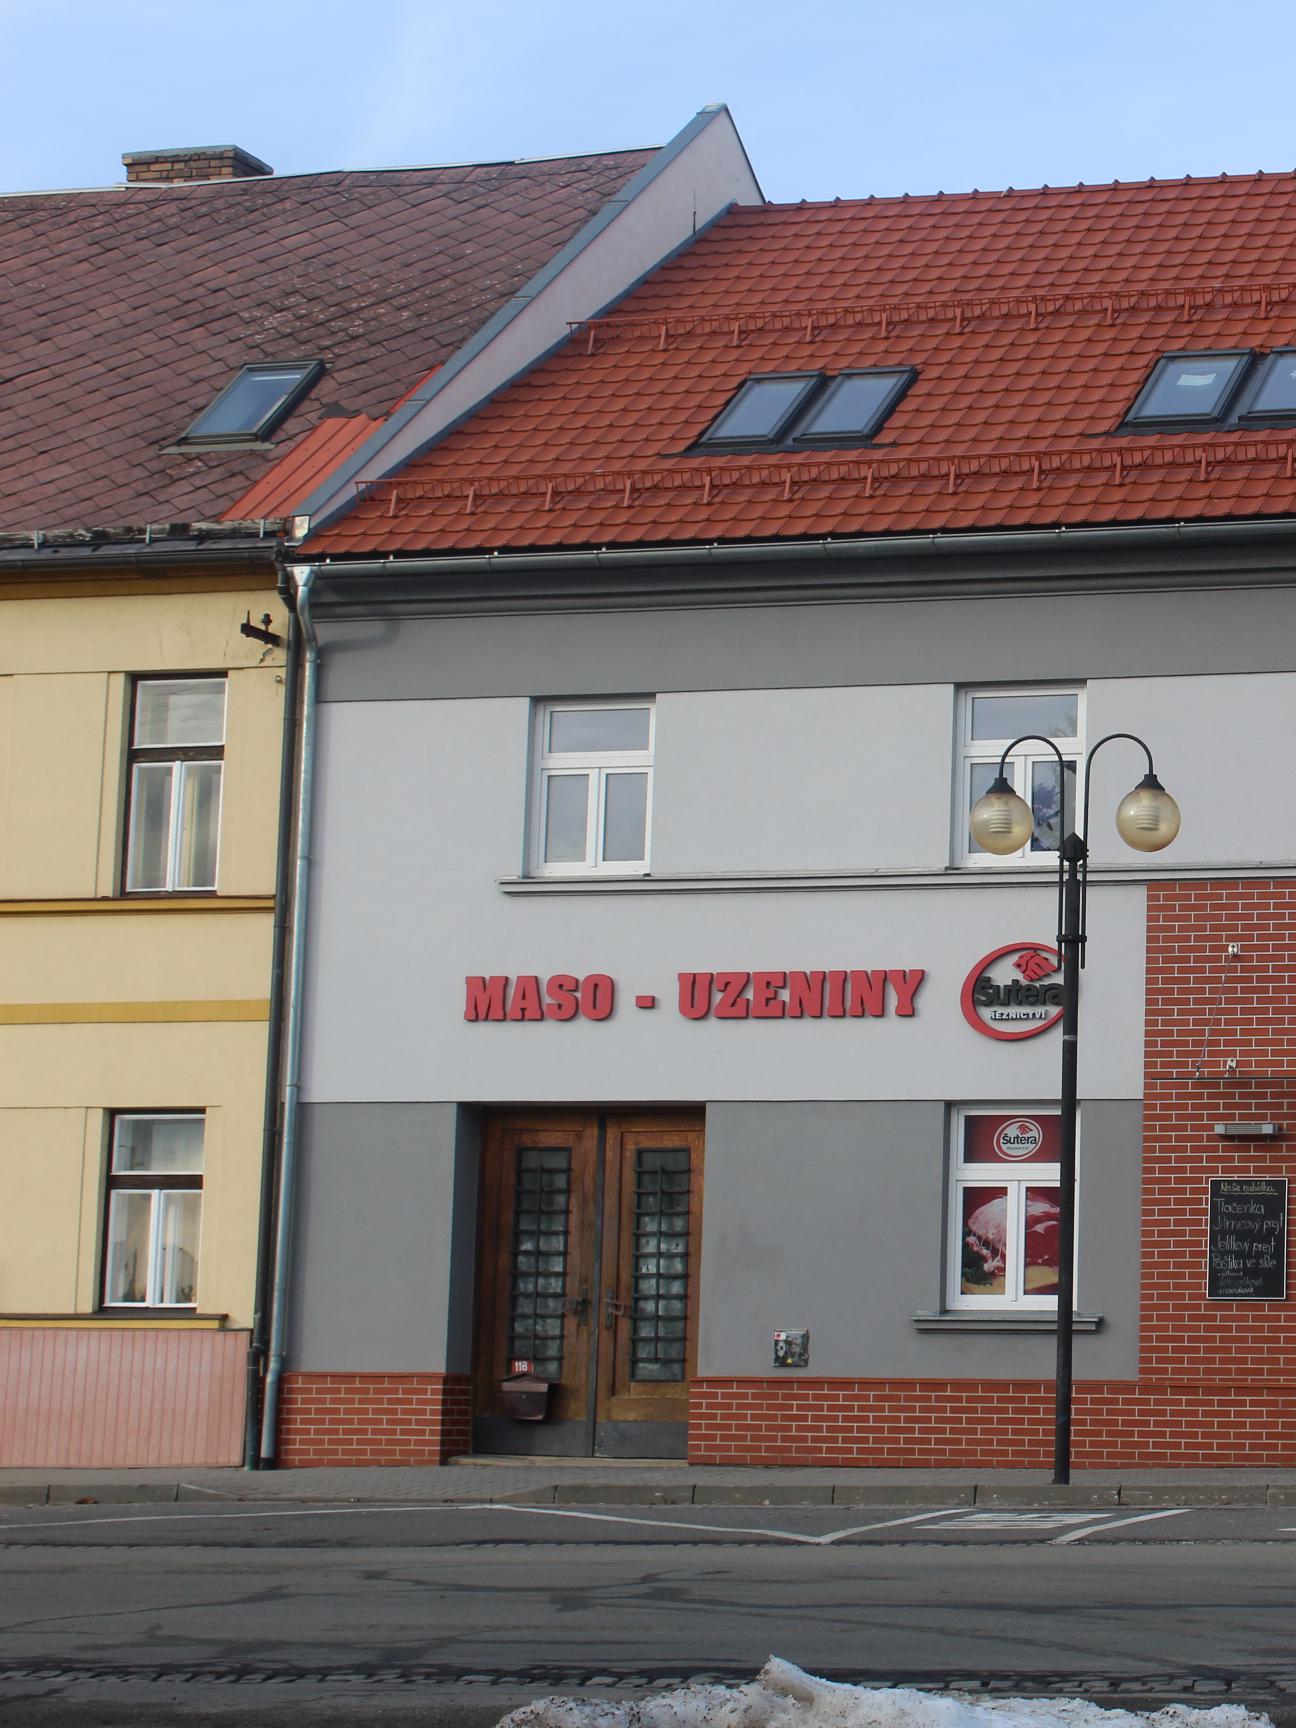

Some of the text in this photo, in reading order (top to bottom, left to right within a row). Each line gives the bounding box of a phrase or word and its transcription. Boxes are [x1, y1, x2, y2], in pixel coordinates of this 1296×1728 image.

[464, 974, 614, 1021] MASO
[677, 969, 925, 1019] UZENINY
[974, 976, 1065, 1006] Šutera
[1002, 1133, 1037, 1145] Šutera
[1213, 1198, 1265, 1214] Tlačenka
